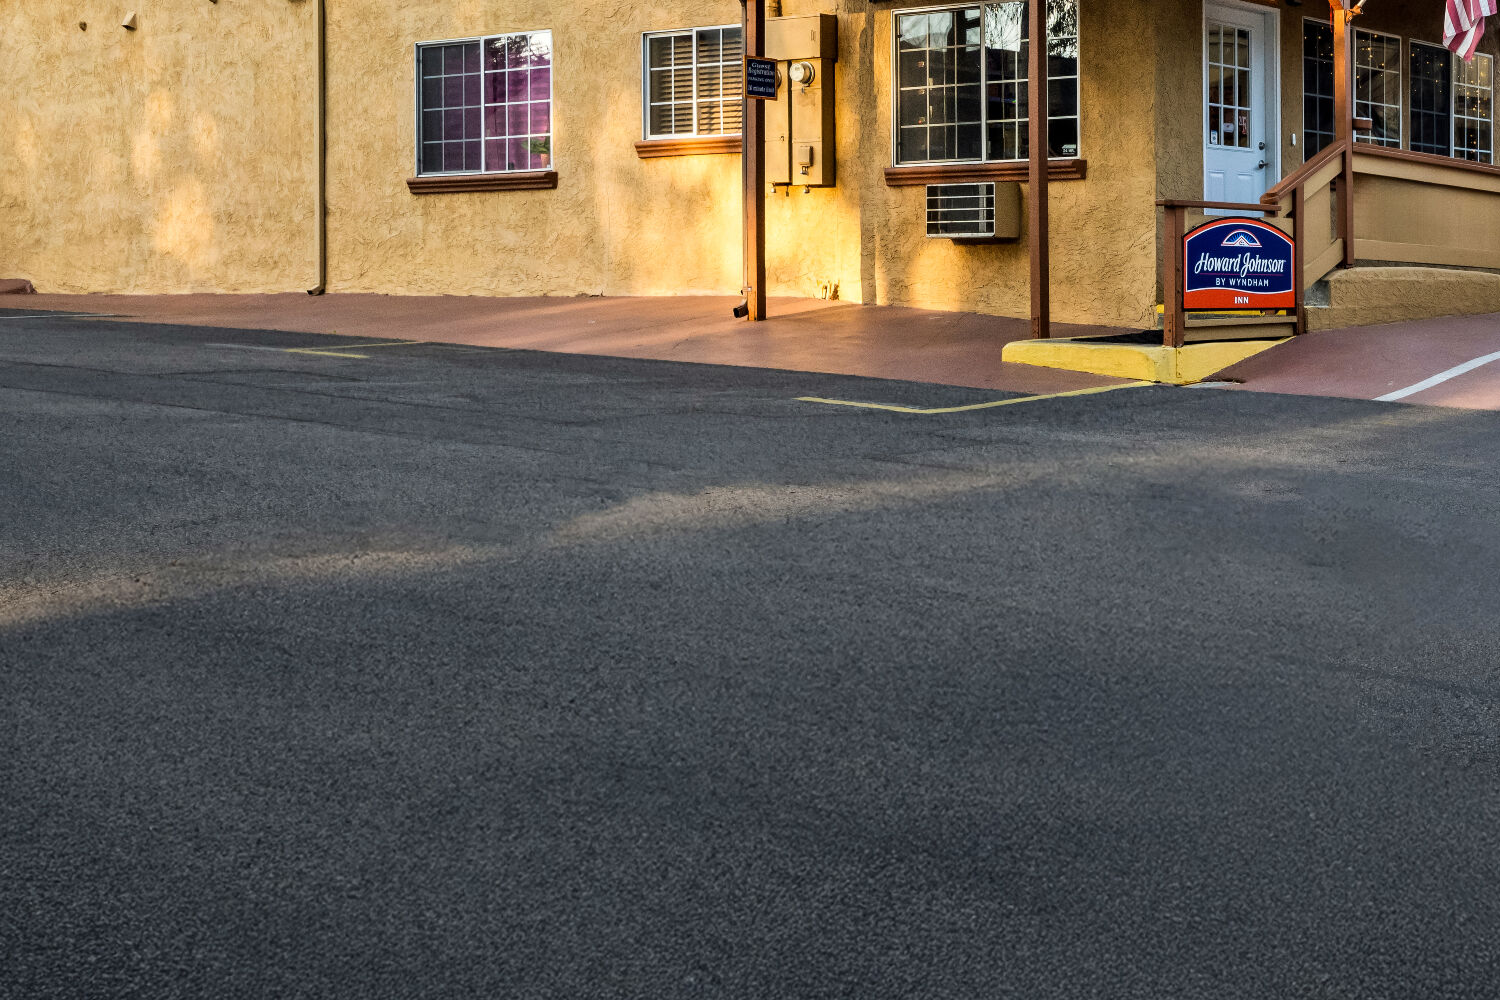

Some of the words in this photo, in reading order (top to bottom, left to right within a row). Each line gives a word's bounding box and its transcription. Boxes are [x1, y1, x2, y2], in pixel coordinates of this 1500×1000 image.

[1194, 252, 1242, 274] Howard
[1240, 252, 1287, 278] Johnson
[1215, 277, 1226, 286] BY
[1229, 278, 1269, 287] WYNDHAM
[1234, 296, 1249, 304] INN
